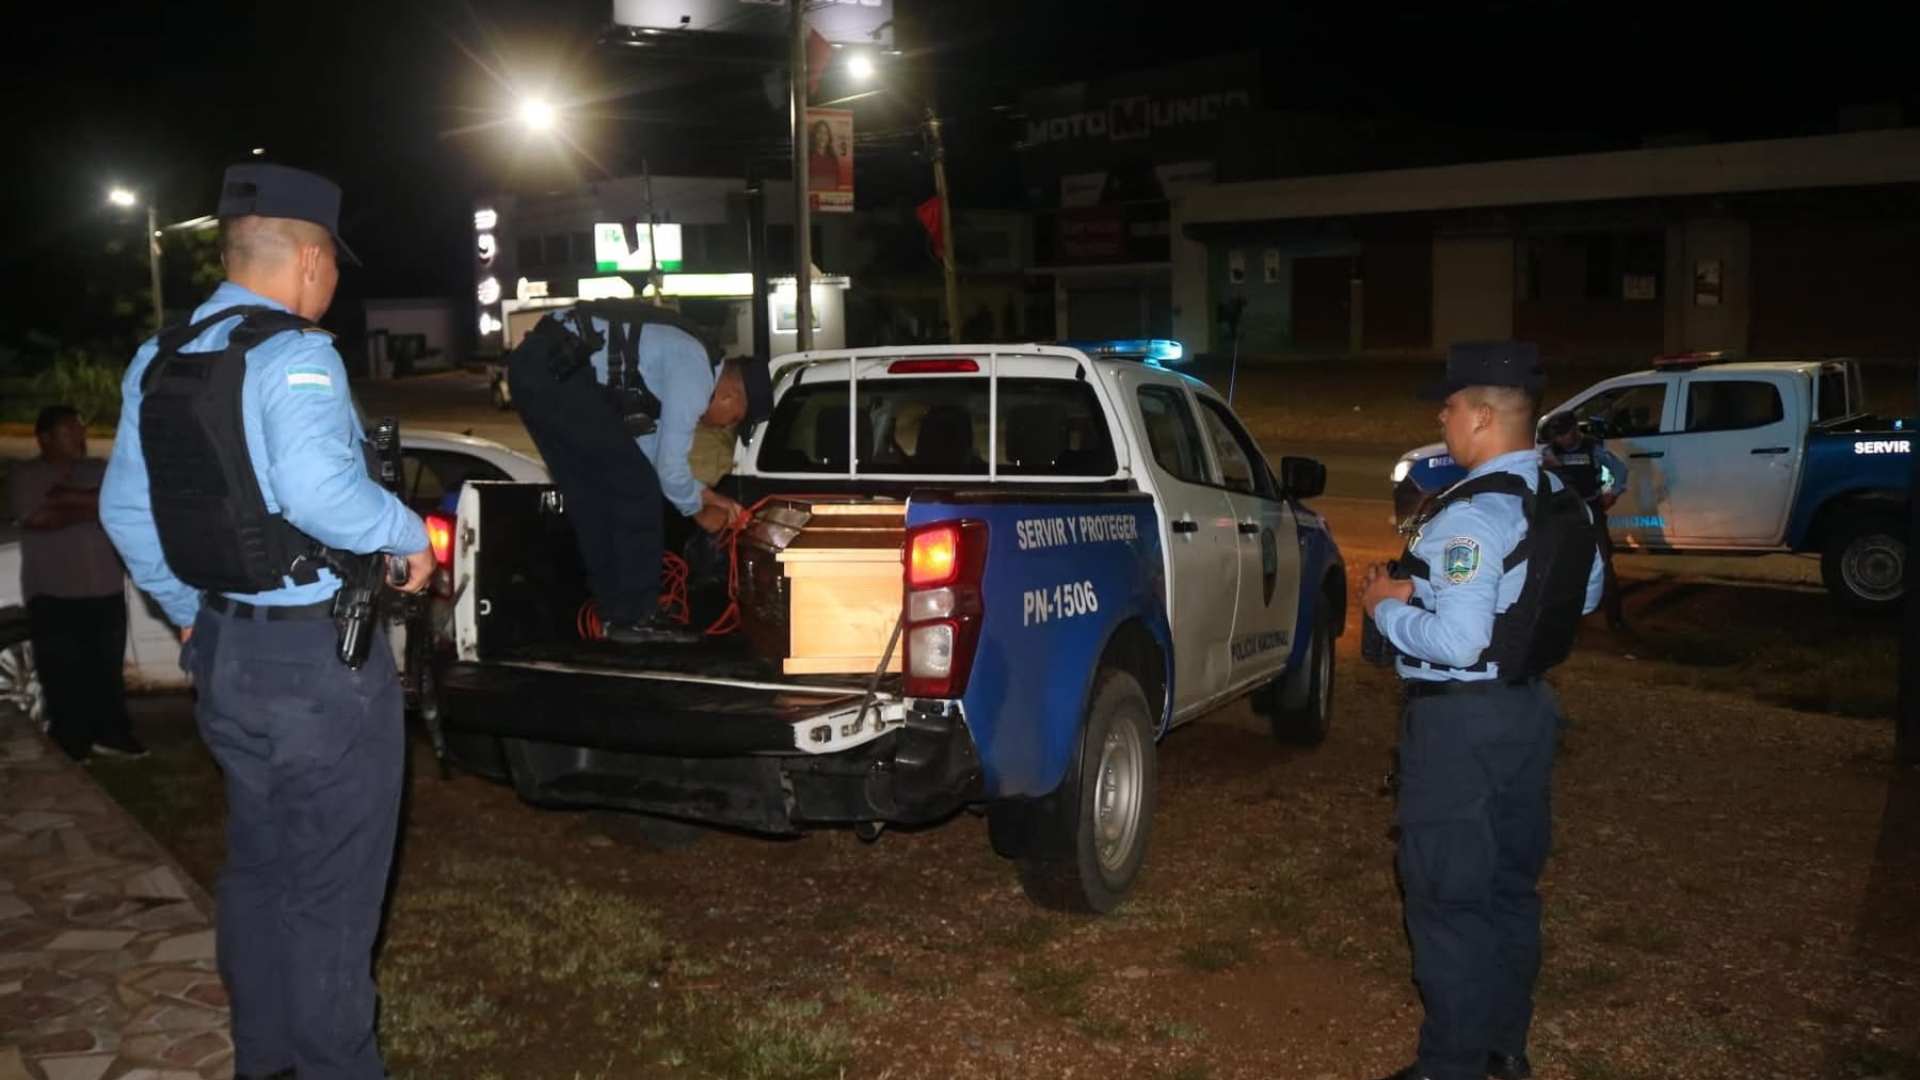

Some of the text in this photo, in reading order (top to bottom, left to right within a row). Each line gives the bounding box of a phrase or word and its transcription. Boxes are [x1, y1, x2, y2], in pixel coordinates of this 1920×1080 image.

[1854, 440, 1911, 455] SERVIR
[1016, 514, 1138, 550] SERVIR Y PROTEGER
[1023, 580, 1098, 627] PN-1506
